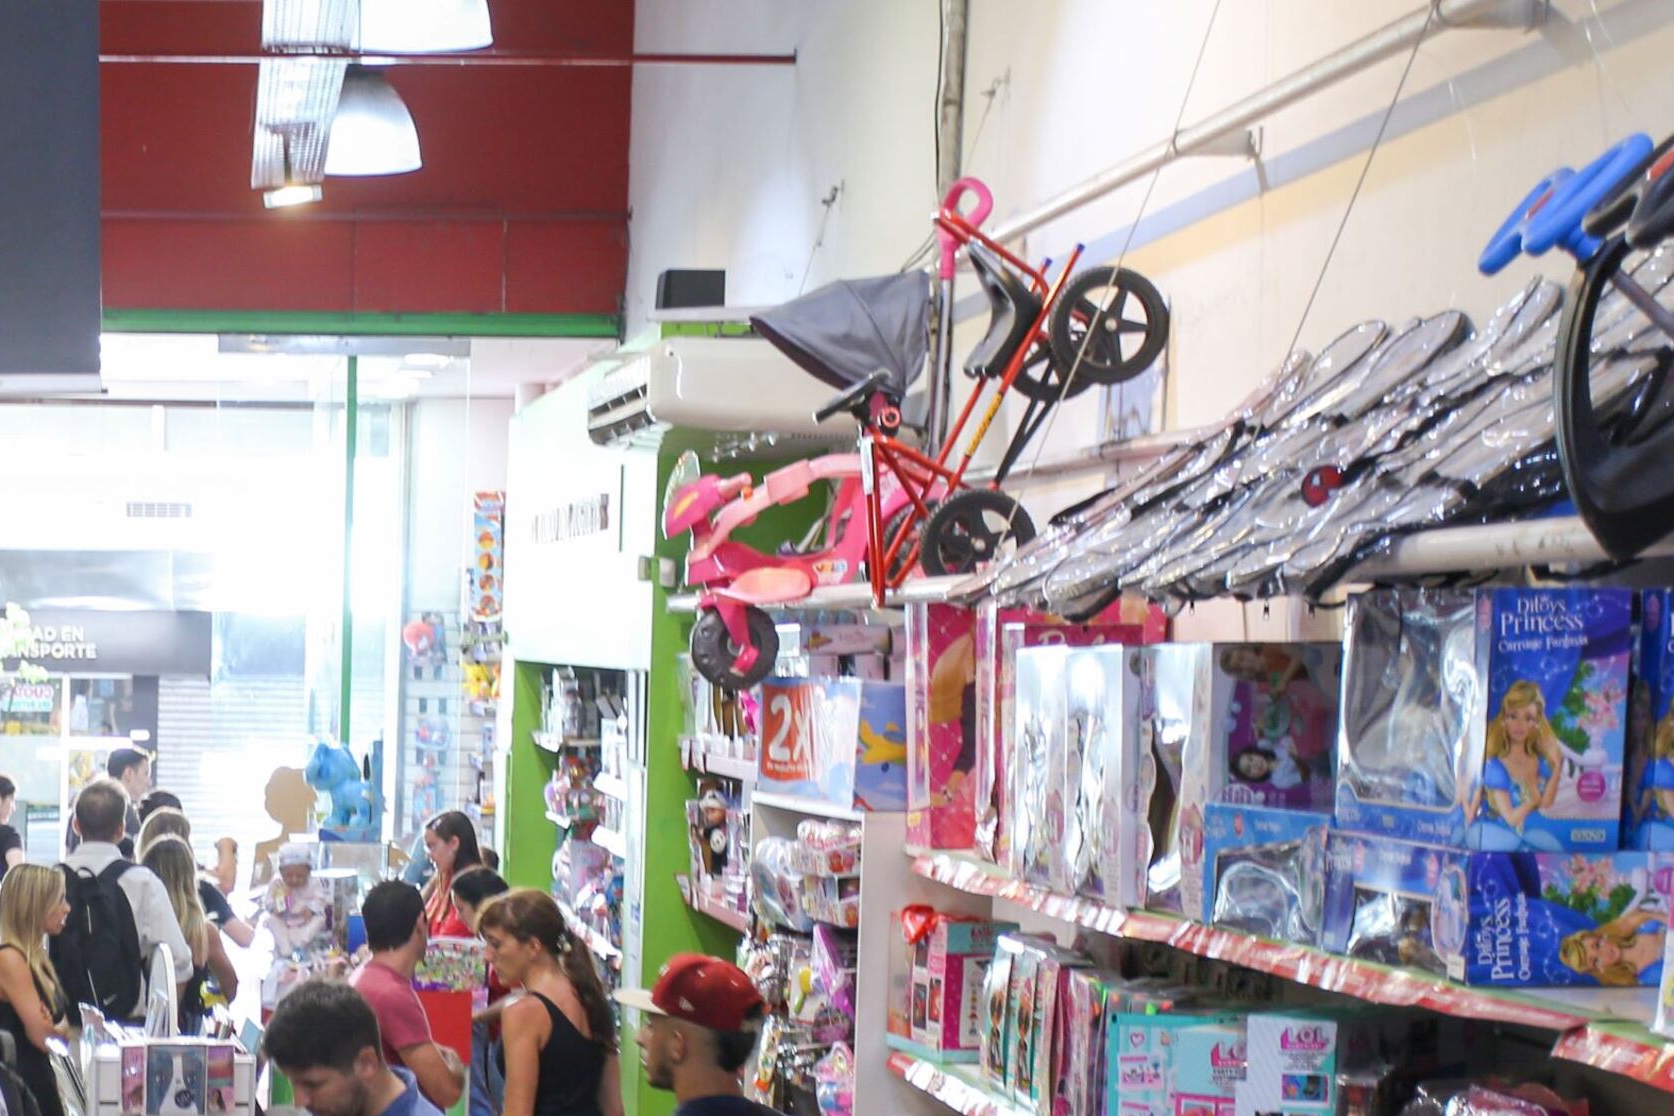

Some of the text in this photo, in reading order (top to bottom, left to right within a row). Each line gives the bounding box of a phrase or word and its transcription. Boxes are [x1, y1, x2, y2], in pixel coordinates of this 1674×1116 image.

[60, 625, 85, 642] EN
[1500, 612, 1584, 639] Princess
[1490, 895, 1511, 982] Princess
